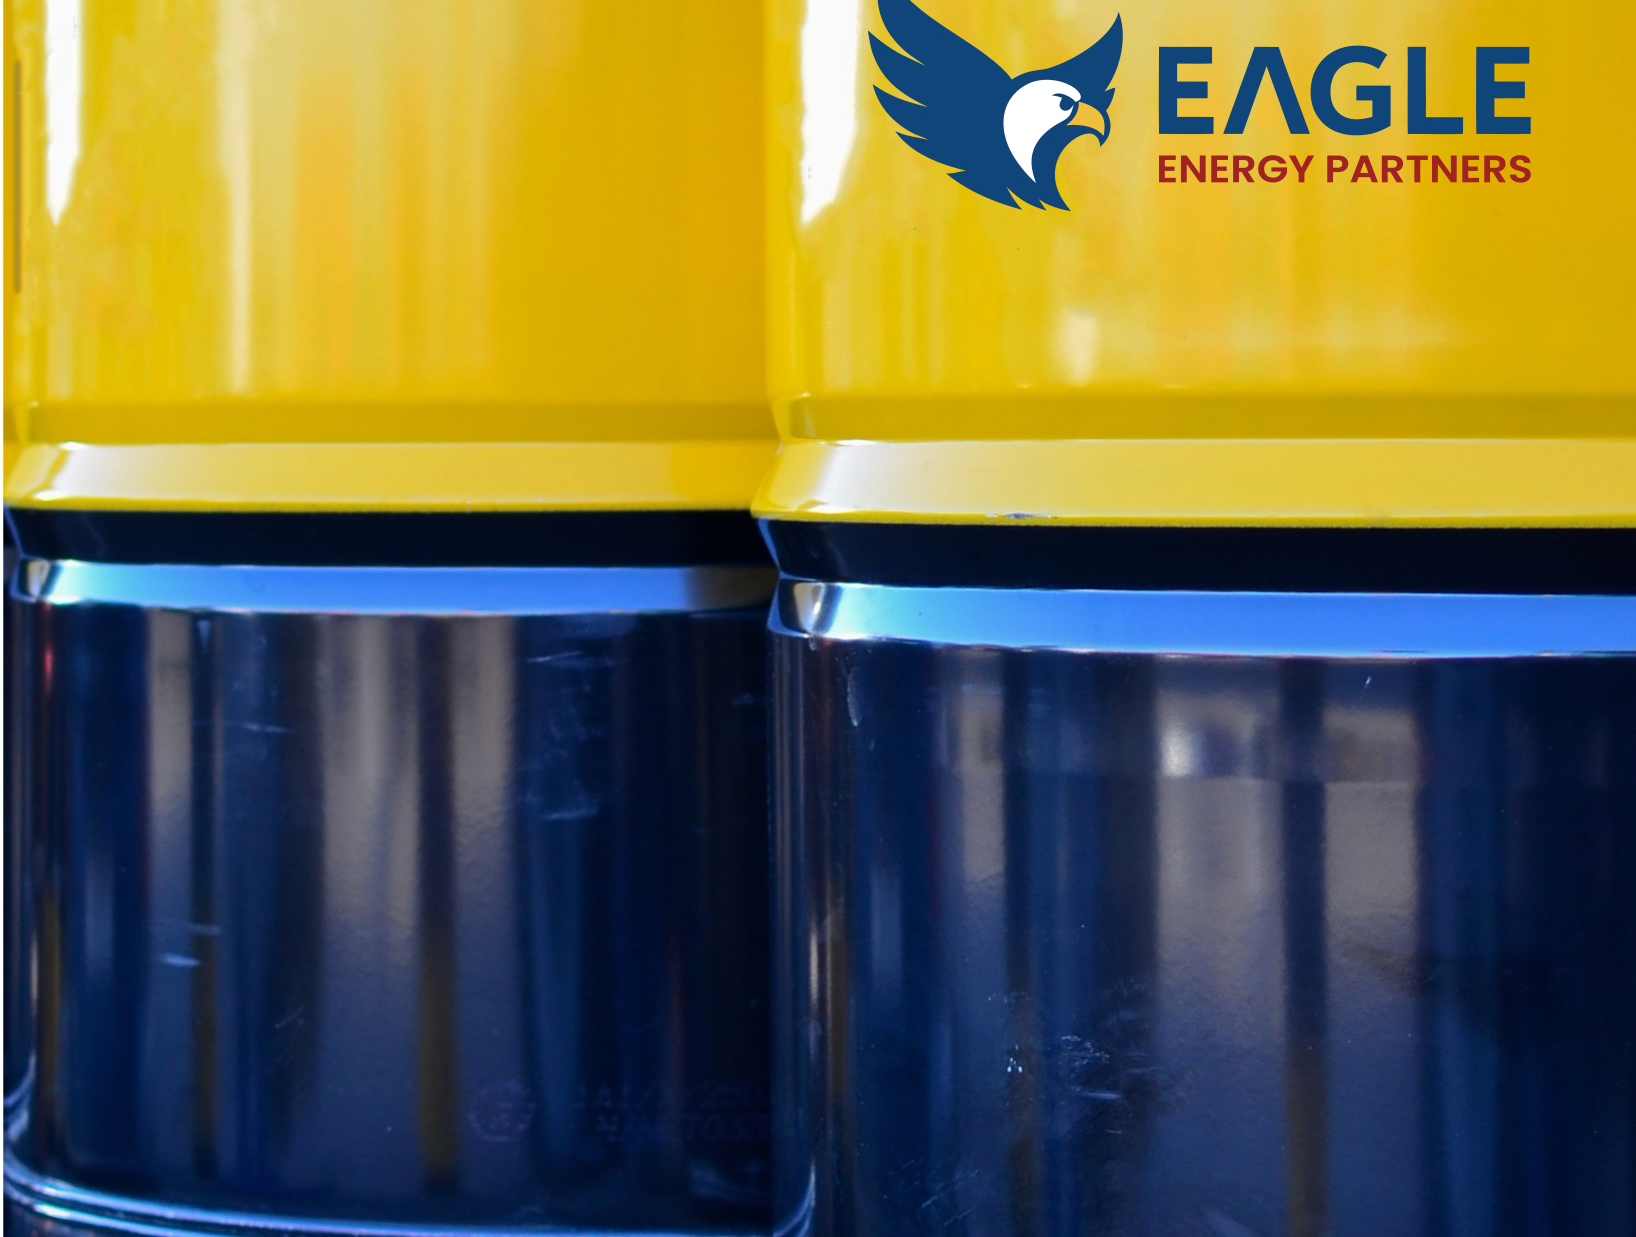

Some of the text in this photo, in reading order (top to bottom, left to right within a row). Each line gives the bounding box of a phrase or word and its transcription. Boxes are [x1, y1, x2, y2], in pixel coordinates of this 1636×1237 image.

[1159, 46, 1531, 135] EAGLE
[1159, 155, 1531, 183] ENERGY PARTNERS
